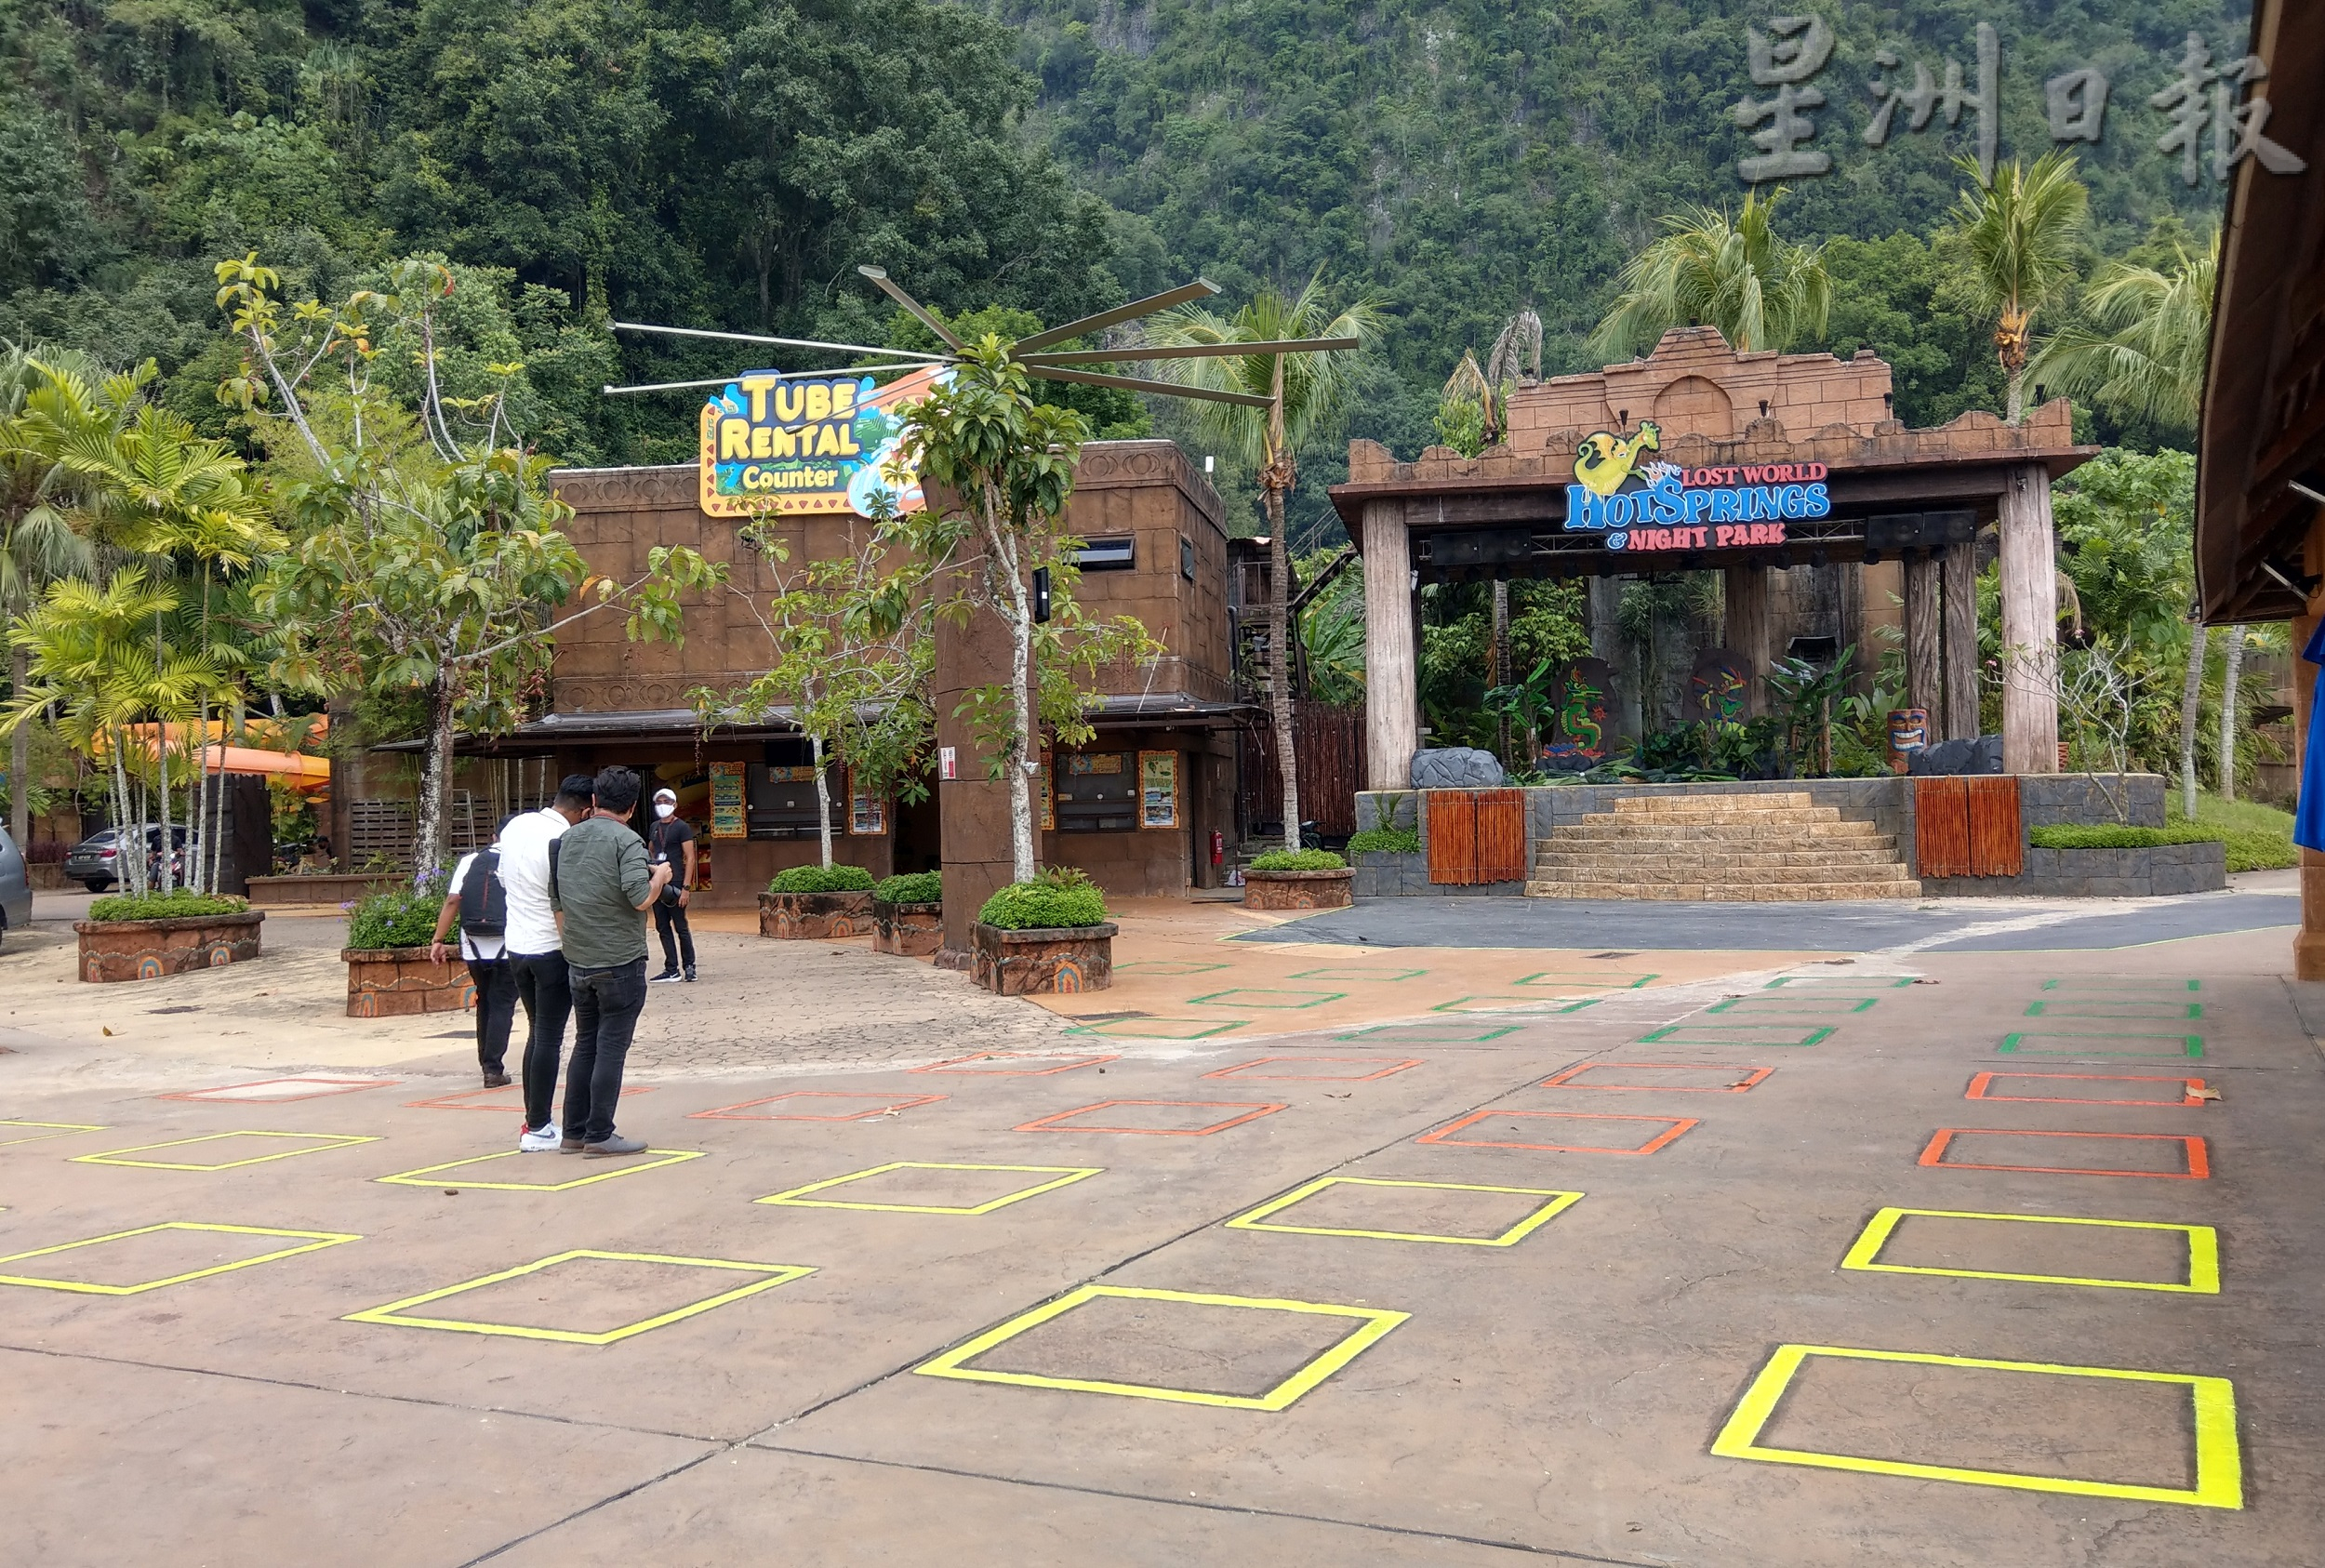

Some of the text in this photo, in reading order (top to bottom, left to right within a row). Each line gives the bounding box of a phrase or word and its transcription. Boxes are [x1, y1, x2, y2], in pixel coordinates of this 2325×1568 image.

[742, 377, 857, 423] TUBE
[721, 419, 860, 460] RENTAL
[743, 465, 839, 489] Counter
[1682, 463, 1827, 486] LOST WORLD
[1607, 523, 1786, 551] & NIGHT PARK
